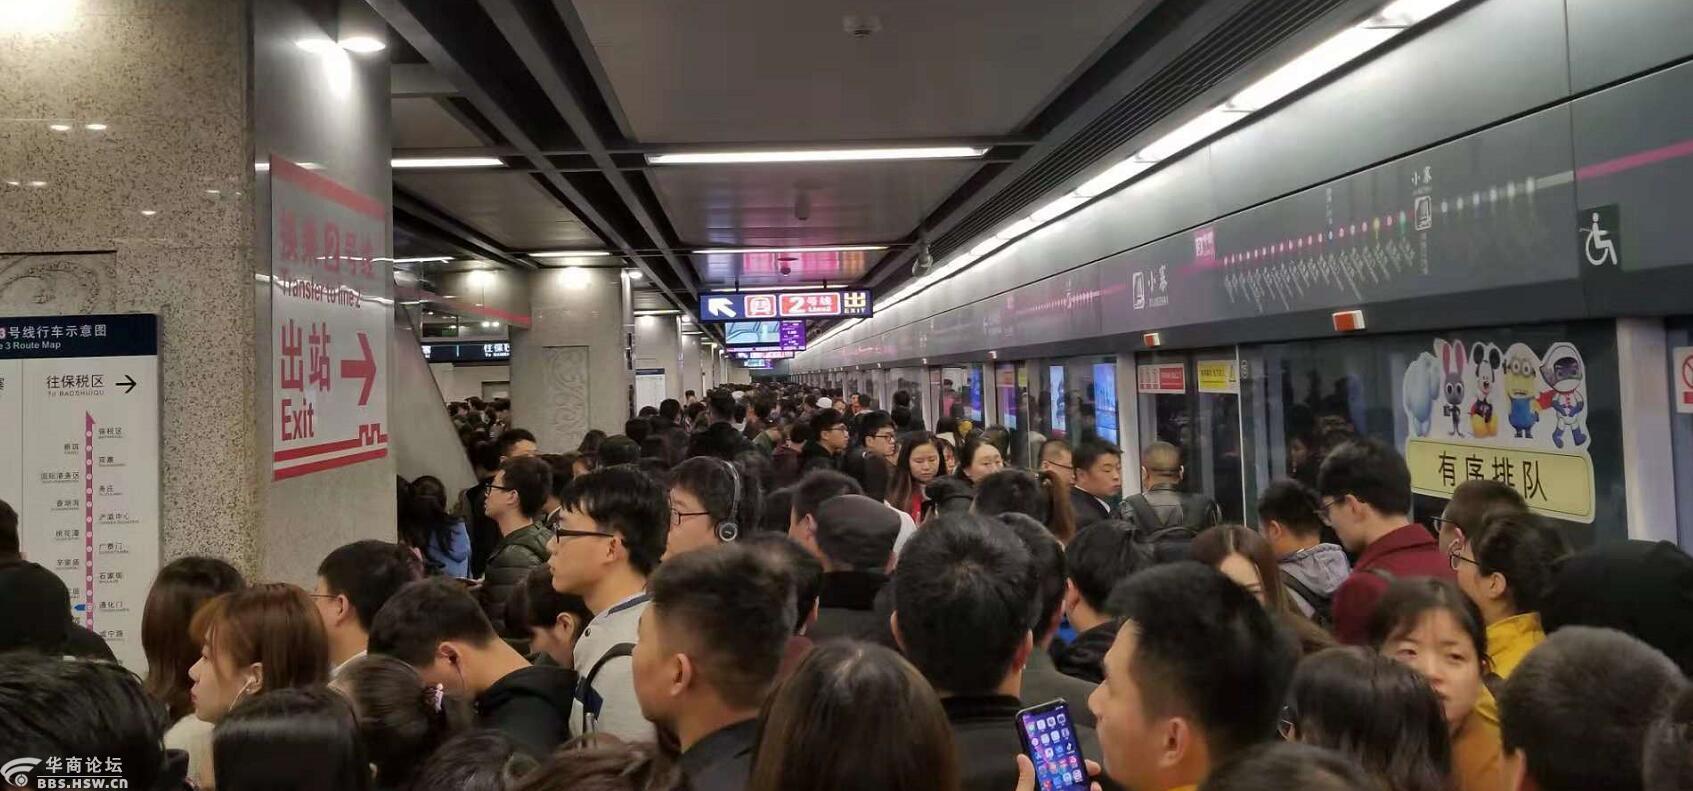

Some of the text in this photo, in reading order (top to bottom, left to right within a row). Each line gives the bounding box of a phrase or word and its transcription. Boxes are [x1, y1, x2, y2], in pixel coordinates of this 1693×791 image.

[280, 268, 324, 303] Transfer
[326, 285, 336, 304] to
[5, 342, 11, 350] 3
[12, 341, 40, 350] Route
[41, 341, 62, 351] Map
[281, 318, 331, 392] 出站
[46, 374, 104, 389] 往保税区
[281, 397, 314, 441] Exit
[1437, 450, 1548, 501] 有序排队
